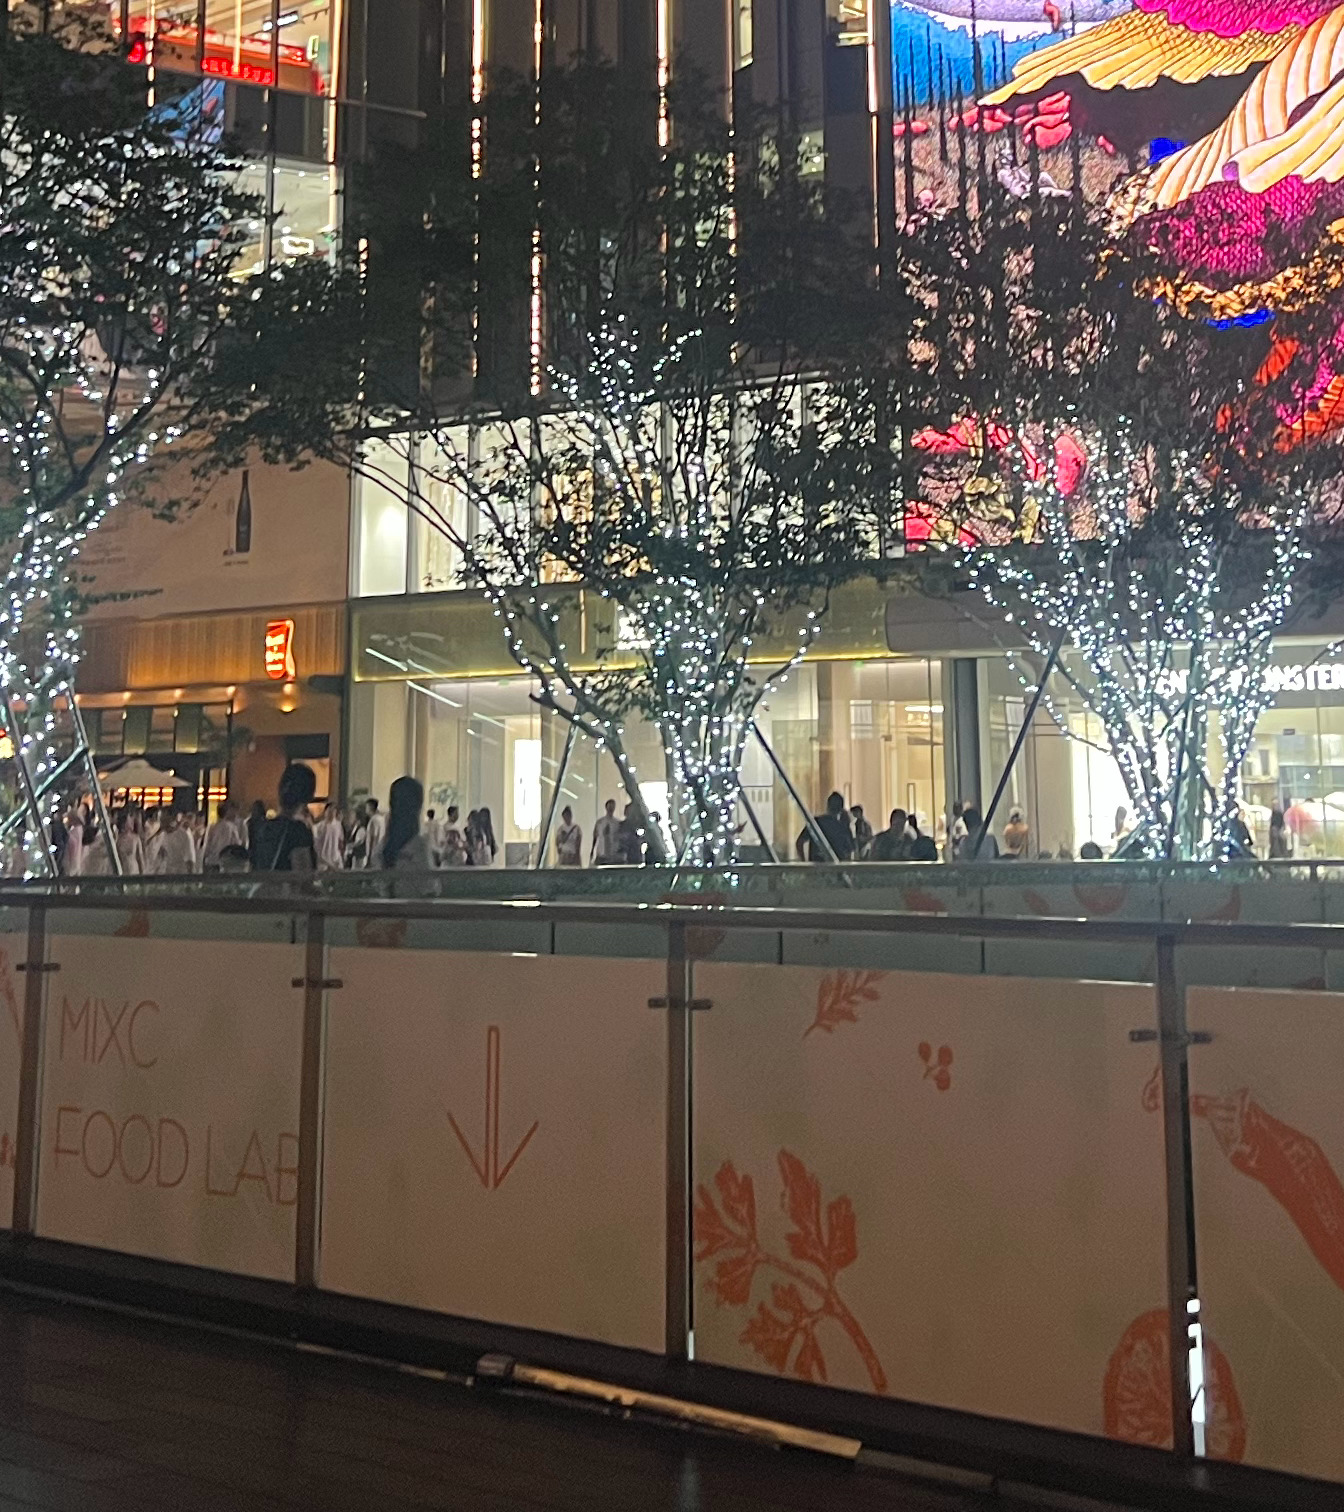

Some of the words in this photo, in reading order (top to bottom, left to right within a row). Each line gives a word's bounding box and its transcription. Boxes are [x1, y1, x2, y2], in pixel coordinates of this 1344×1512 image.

[58, 996, 161, 1070] MIXC
[54, 1105, 190, 1189] FOOD
[205, 1123, 300, 1207] LAB
